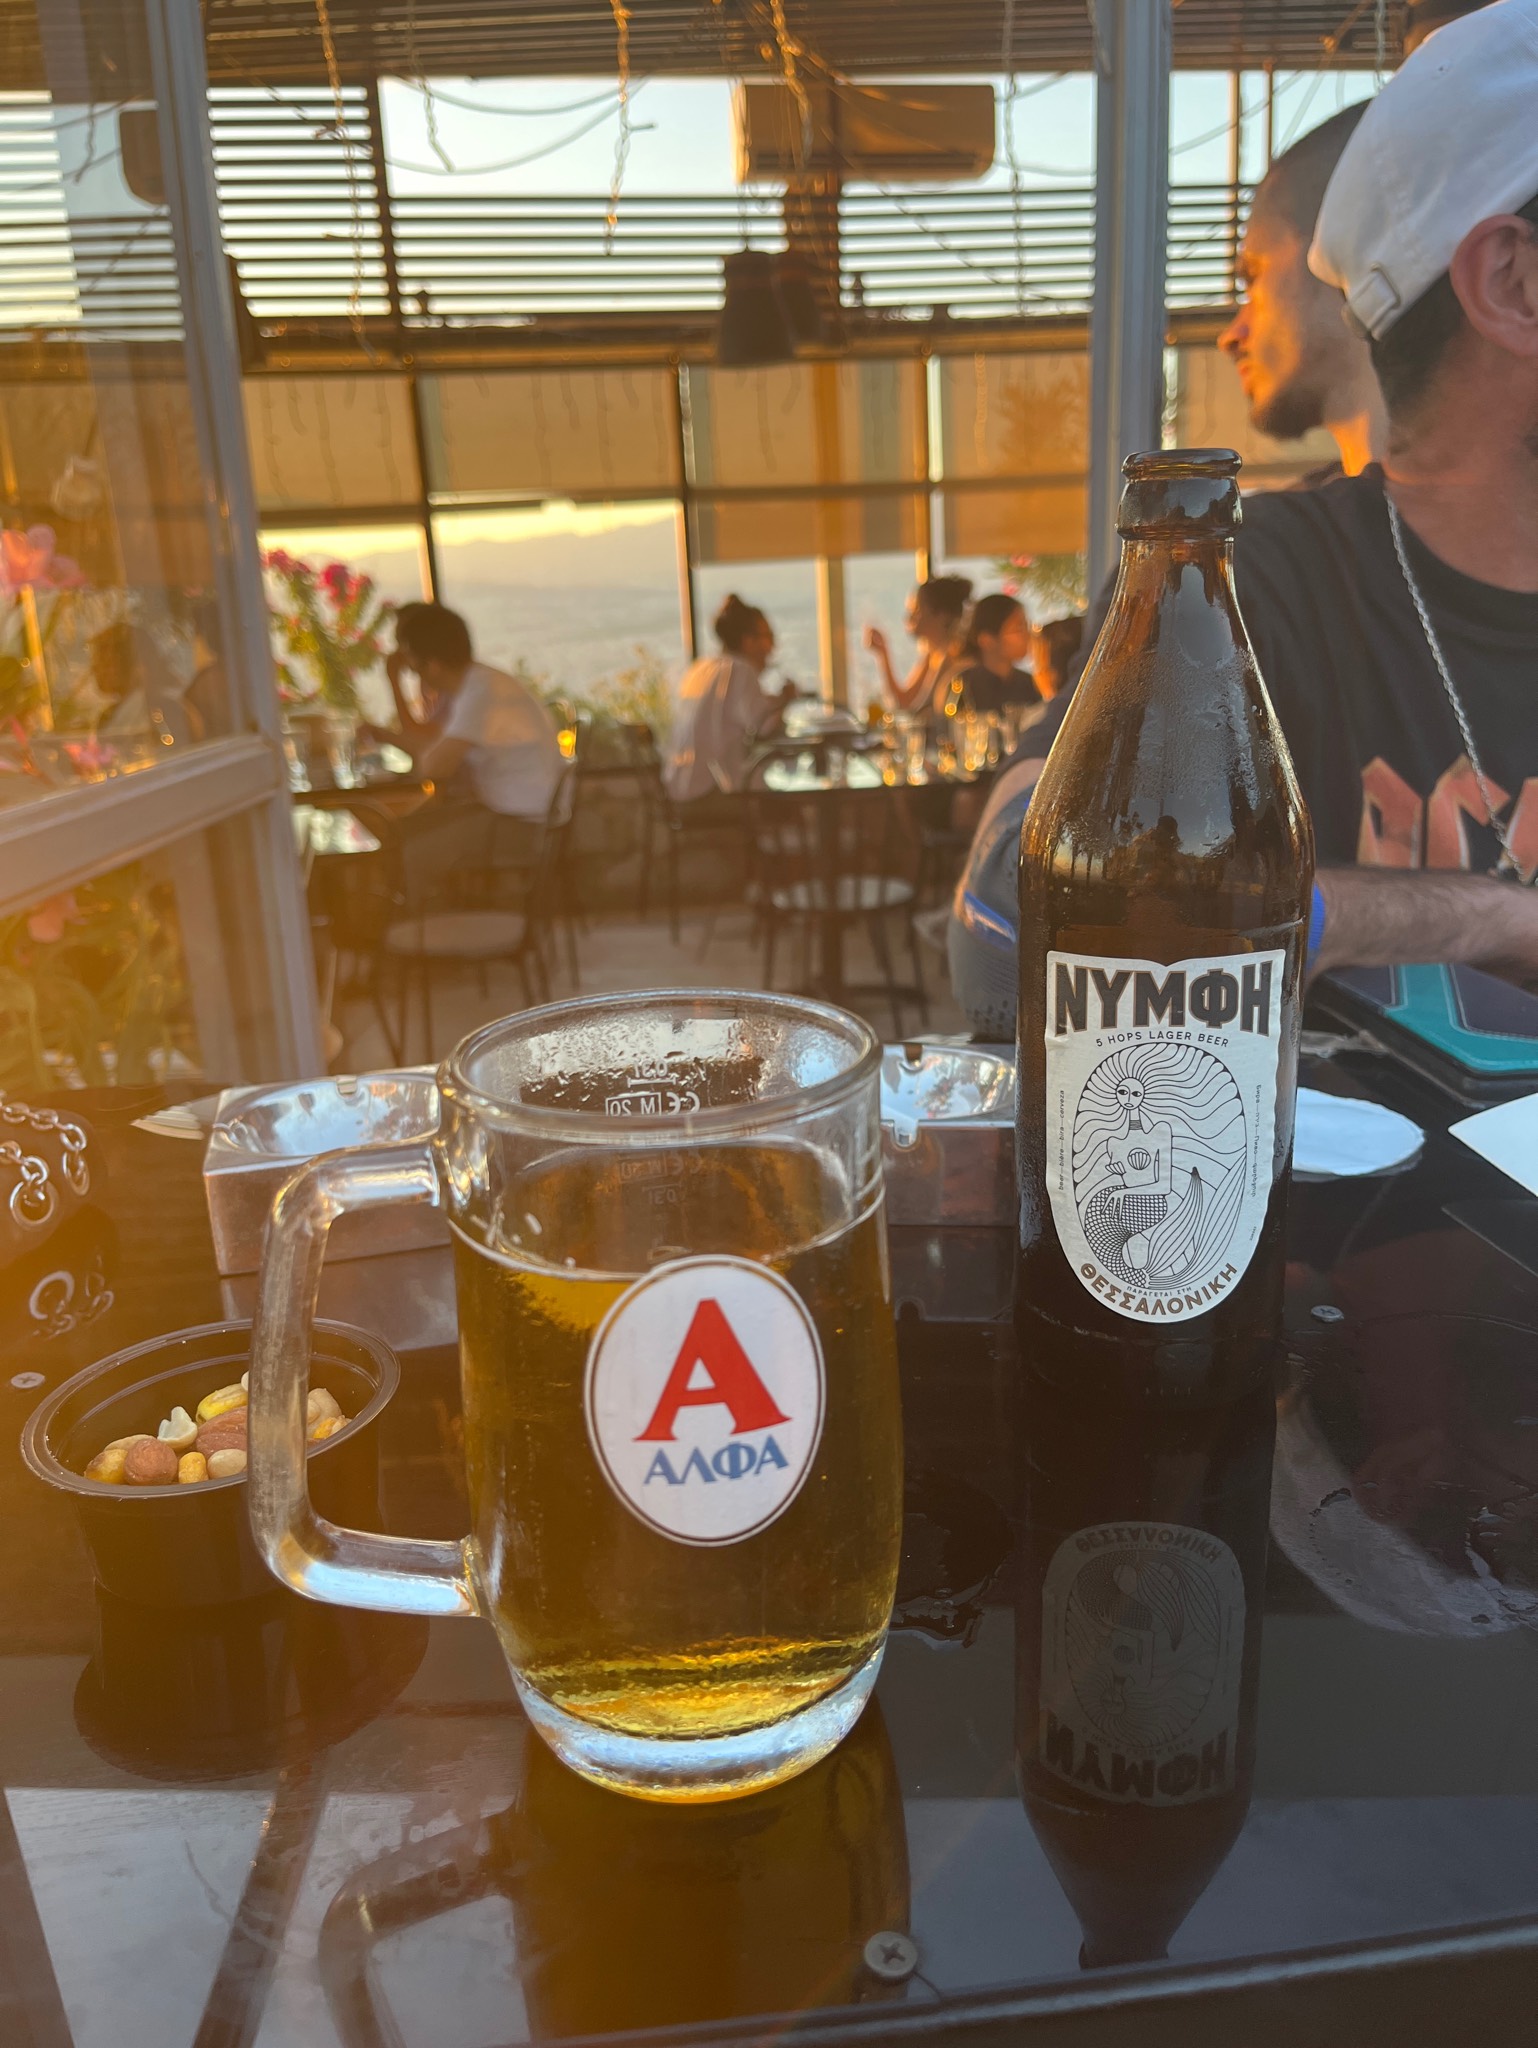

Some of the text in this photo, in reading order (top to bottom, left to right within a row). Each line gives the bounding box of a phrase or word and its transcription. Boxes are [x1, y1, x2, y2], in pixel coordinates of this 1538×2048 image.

[1054, 960, 1273, 1037] ΝΥΜΦΗ
[1095, 1030, 1229, 1048] 5 HOPS LAGER BEER
[1080, 1262, 1238, 1315] ΘΕΣΣΑΛΟΝΙΚΗ
[1126, 1286, 1192, 1297] ΠΑΡΑΓΕΤΑΙ ΣΤΗ
[643, 1434, 789, 1486] ΑΛΦΑ
